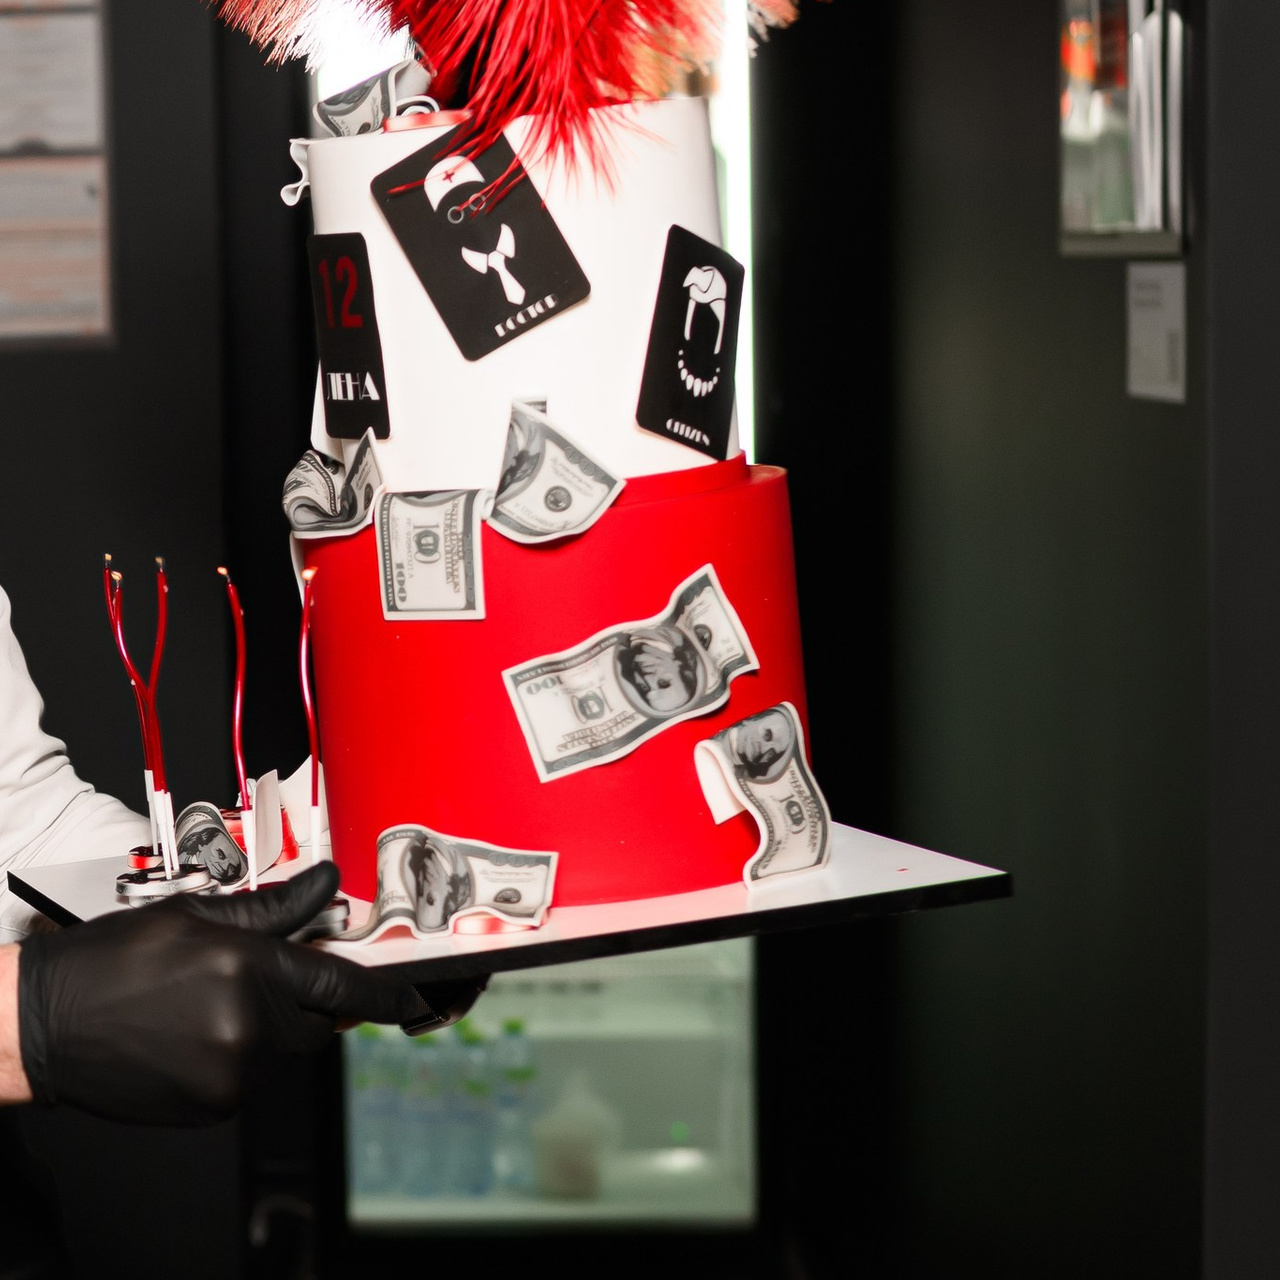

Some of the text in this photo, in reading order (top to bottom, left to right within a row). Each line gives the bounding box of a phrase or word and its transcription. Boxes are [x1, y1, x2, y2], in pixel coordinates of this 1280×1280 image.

[318, 256, 363, 329] 12
[494, 293, 558, 337] DOCTOR
[326, 372, 381, 401] ЛЕНА
[665, 418, 710, 446] CITIZEN
[395, 562, 407, 603] 100
